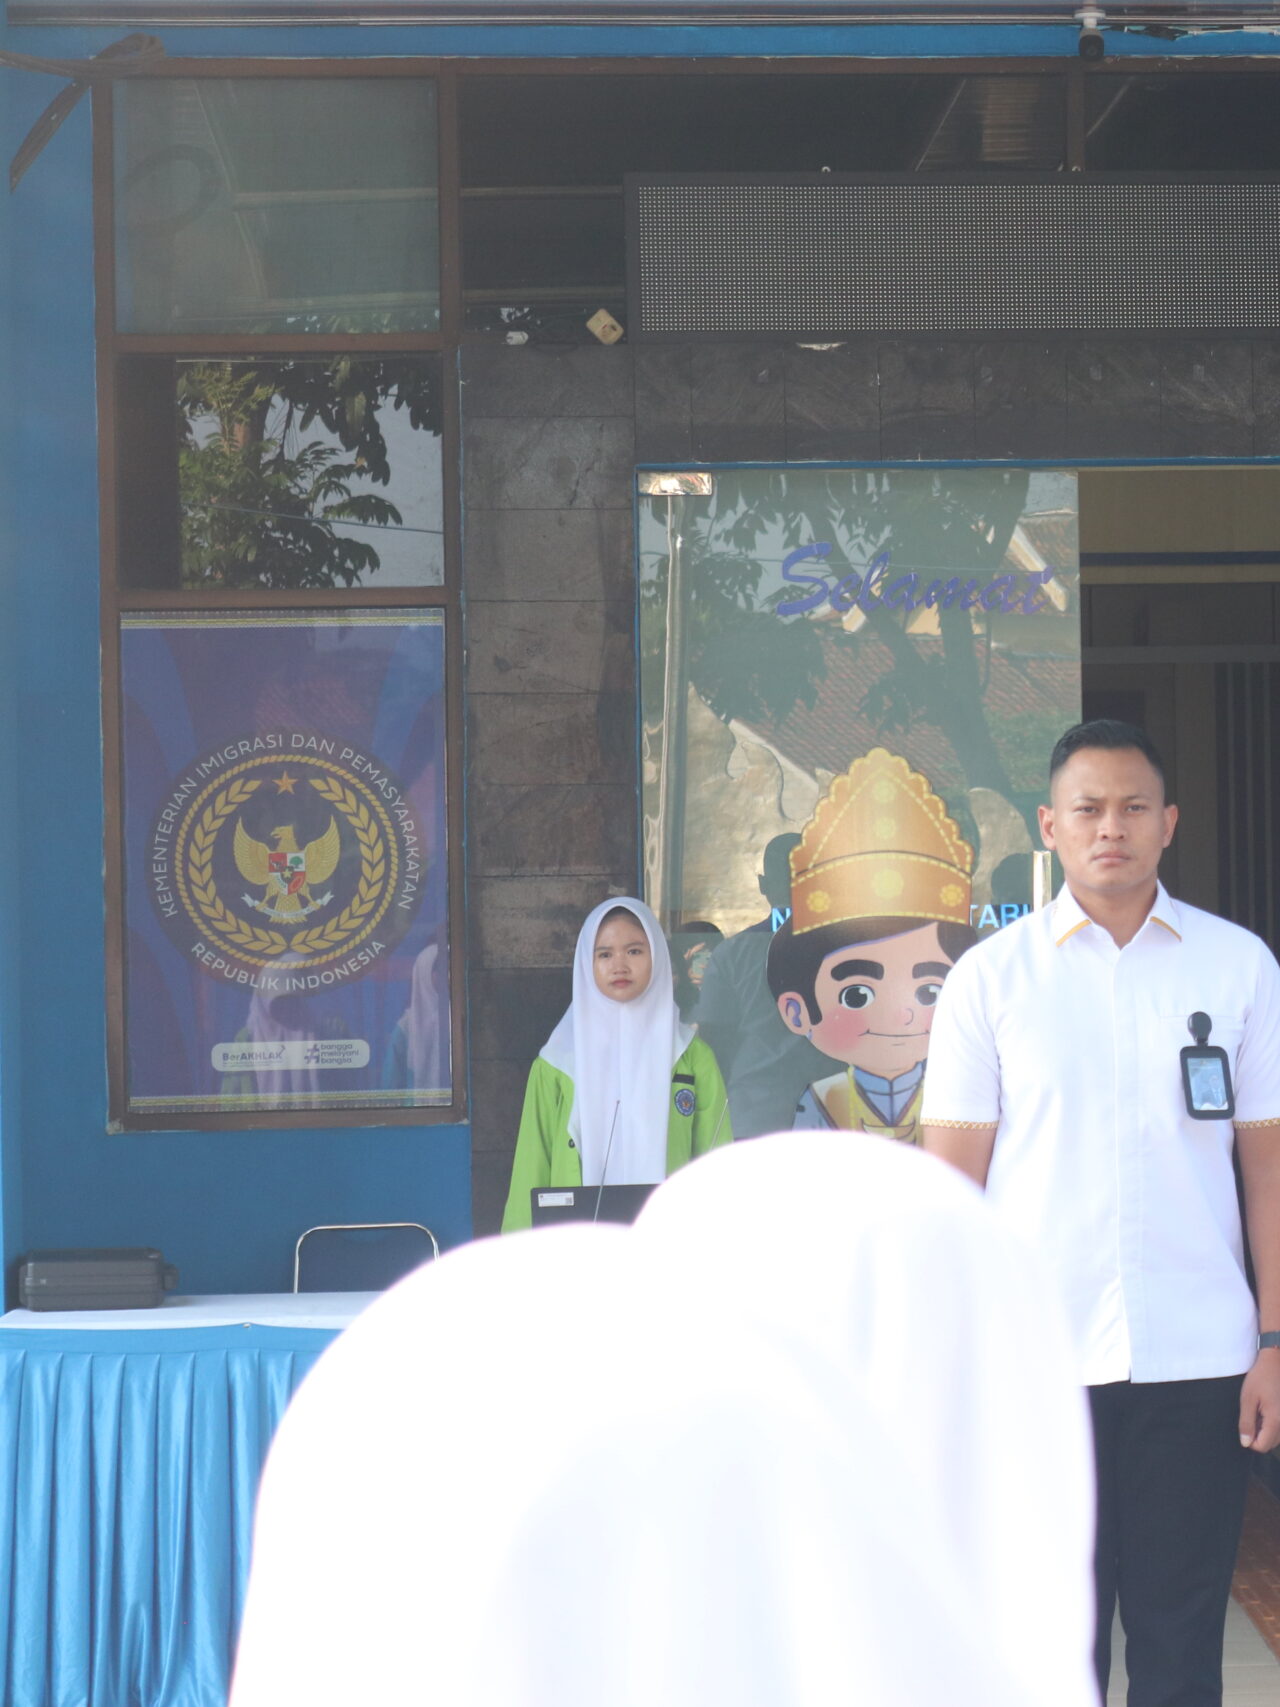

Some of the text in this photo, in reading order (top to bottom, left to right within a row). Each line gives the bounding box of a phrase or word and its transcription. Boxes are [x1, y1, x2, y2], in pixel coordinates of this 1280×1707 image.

[776, 542, 1056, 616] Selamat
[152, 734, 420, 918] KEMENTERIAN IMIGRASI DAN PEMASYARAKATAN
[191, 940, 386, 991] REPUBLIK INDONESIA
